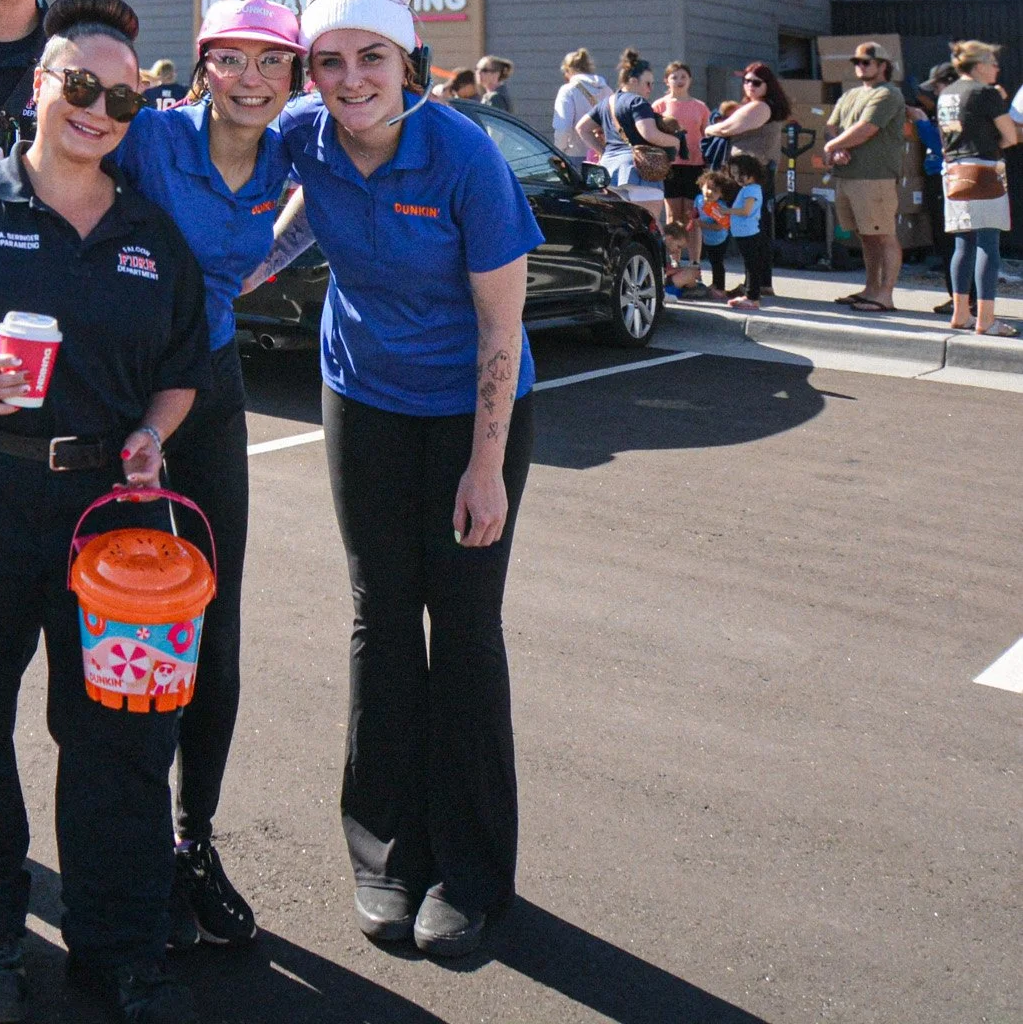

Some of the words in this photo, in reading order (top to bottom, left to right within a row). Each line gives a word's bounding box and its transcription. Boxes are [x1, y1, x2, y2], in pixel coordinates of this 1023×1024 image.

[393, 202, 441, 218] DUNKIN'
[0, 239, 40, 249] PARAMEDIC
[122, 246, 150, 256] FALCON
[118, 253, 156, 272] FIRE
[117, 265, 159, 280] DEPARTMENT
